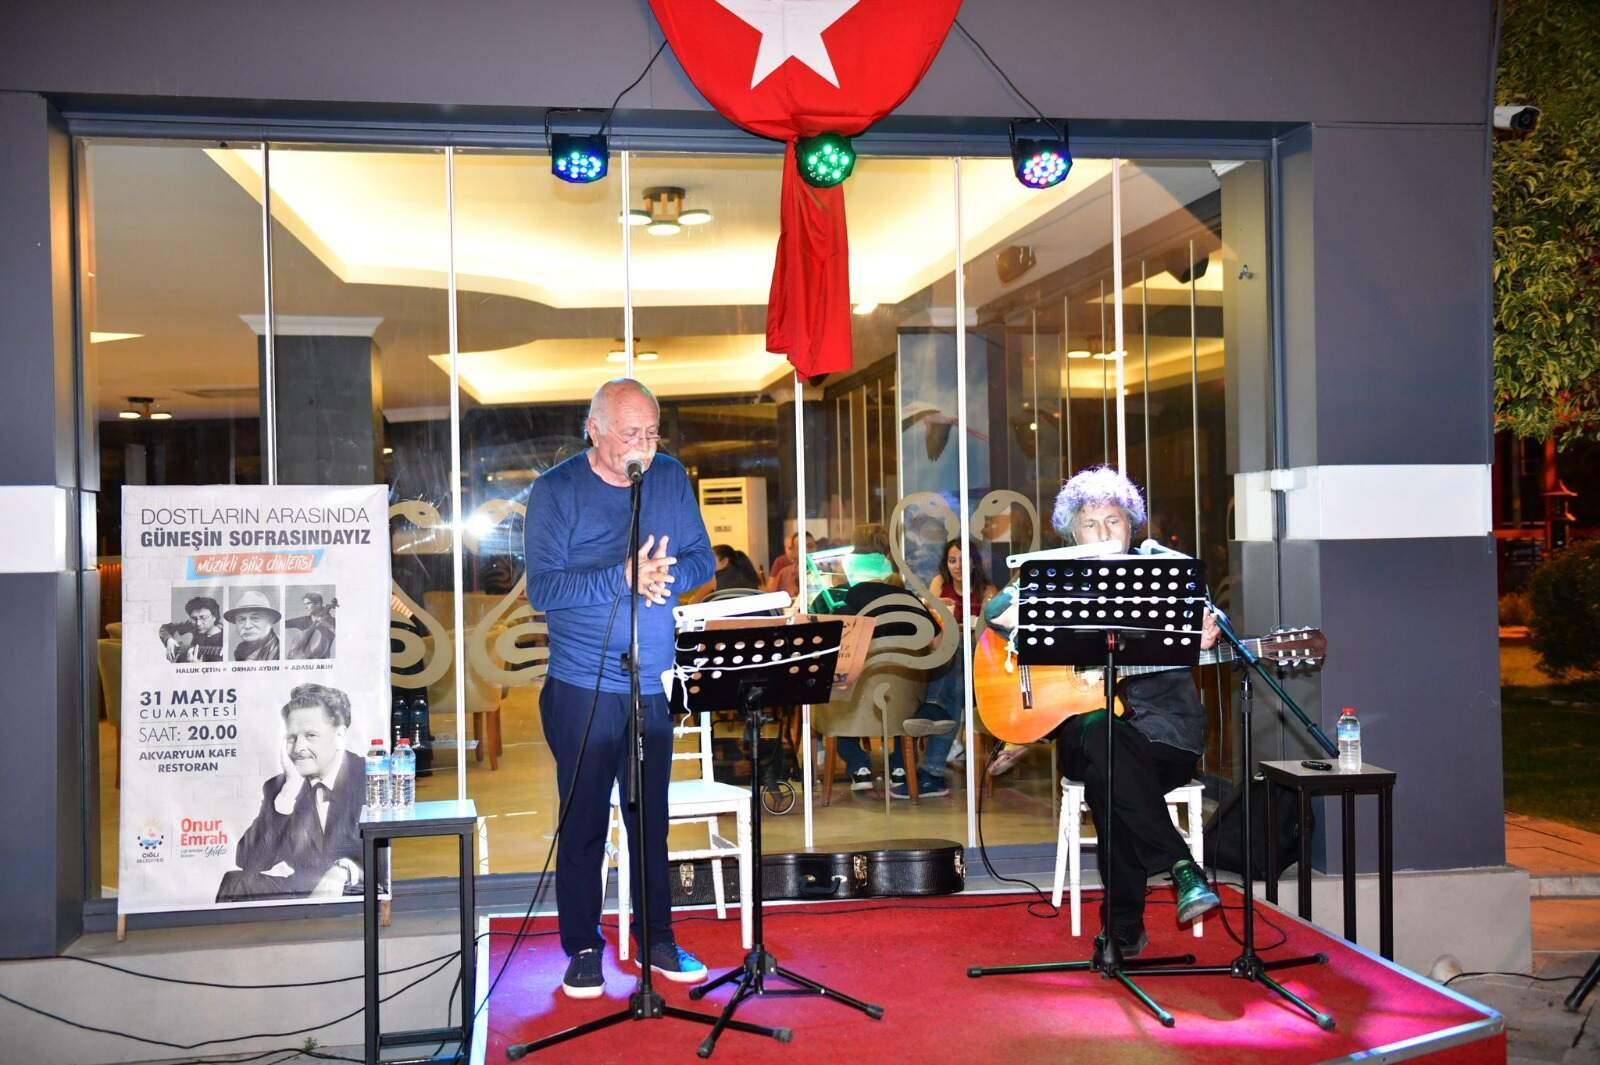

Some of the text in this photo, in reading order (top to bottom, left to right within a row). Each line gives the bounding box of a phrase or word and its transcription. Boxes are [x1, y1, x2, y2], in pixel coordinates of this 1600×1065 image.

[142, 507, 370, 526] DOSTLARIN ARASINDA
[141, 527, 370, 550] GÜNEŞİN SOFRASINDAYIZ
[140, 690, 237, 706] 31 MAYIS
[140, 704, 237, 718] CUMARTESİ
[139, 724, 237, 742] SAAT: 20.00
[139, 748, 237, 760] AKVARYUM KAFE
[158, 762, 218, 773] RESTORAN
[180, 818, 222, 832] Onur
[180, 831, 228, 846] Emrah
